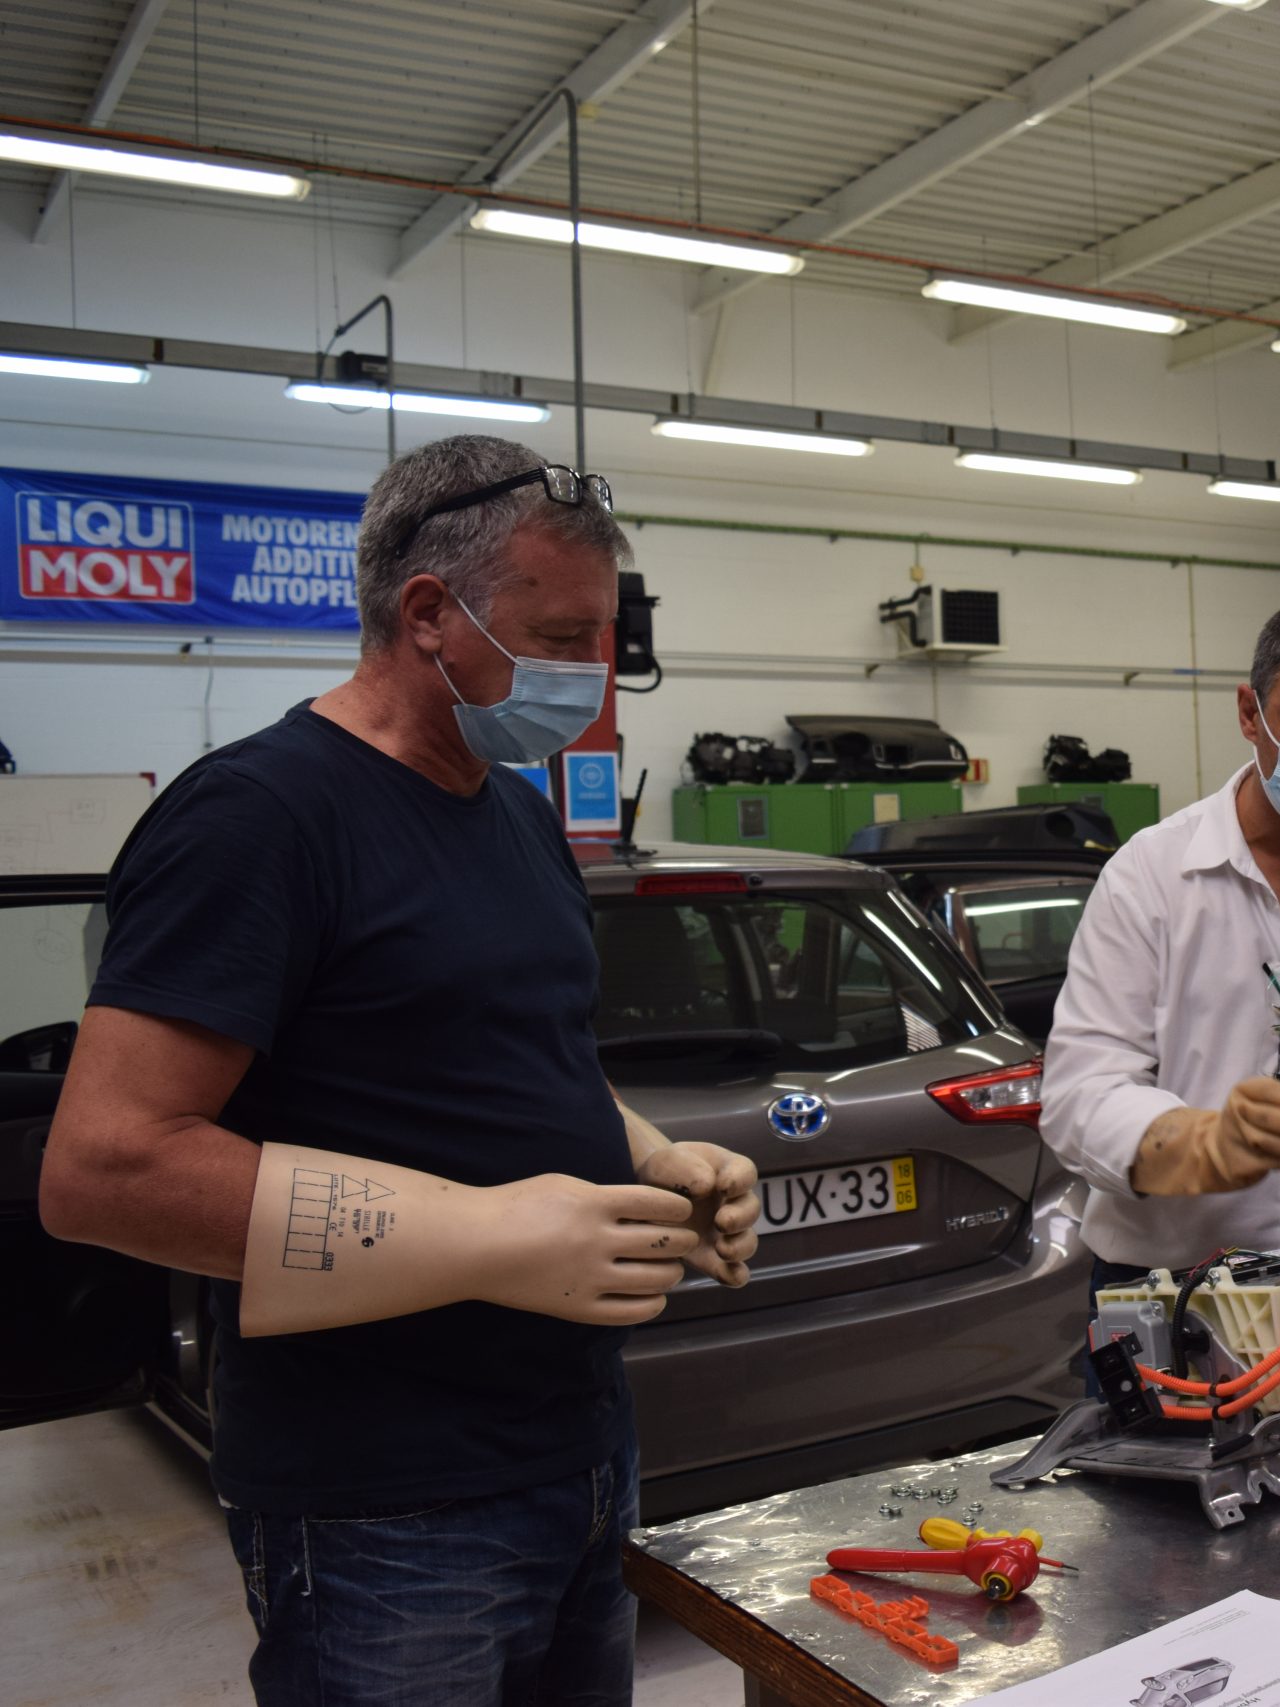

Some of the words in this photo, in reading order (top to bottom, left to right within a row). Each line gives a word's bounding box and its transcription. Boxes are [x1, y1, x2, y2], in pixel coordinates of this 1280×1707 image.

[27, 498, 183, 548] LIQUI
[29, 549, 189, 598] MOLY
[897, 1163, 911, 1179] 18
[895, 1189, 913, 1206] 06
[946, 1211, 998, 1231] HYBRID
